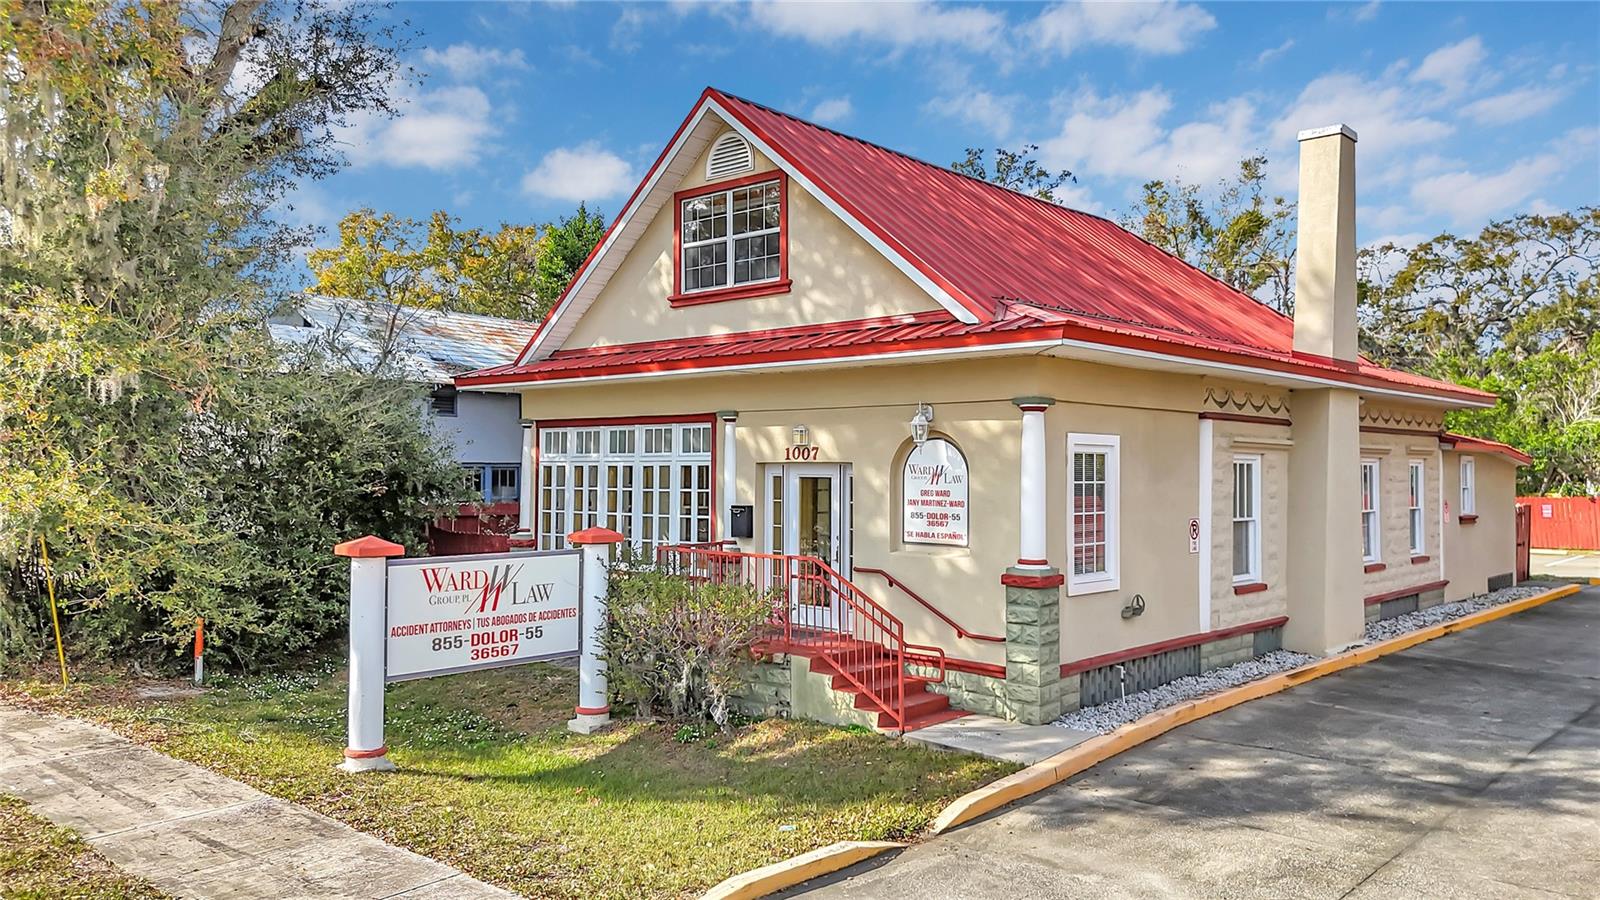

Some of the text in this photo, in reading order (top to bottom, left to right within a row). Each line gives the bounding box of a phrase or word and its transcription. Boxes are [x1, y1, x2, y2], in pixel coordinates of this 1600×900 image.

[785, 446, 819, 461] 1007
[908, 463, 935, 475] WARD
[944, 472, 963, 484] LAW
[920, 489, 934, 497] GREG
[920, 500, 965, 508] MARTINEZ-WARD
[910, 512, 961, 521] 855-DOLOR-55
[420, 567, 490, 593] WARD
[512, 582, 554, 606] LAW
[391, 607, 577, 638] ACCIDENT ATTORNEYS TUS ABOGADOS DE ACCIDENTES
[431, 625, 544, 652] 855-DOLOR-55
[470, 643, 519, 661] 36567
